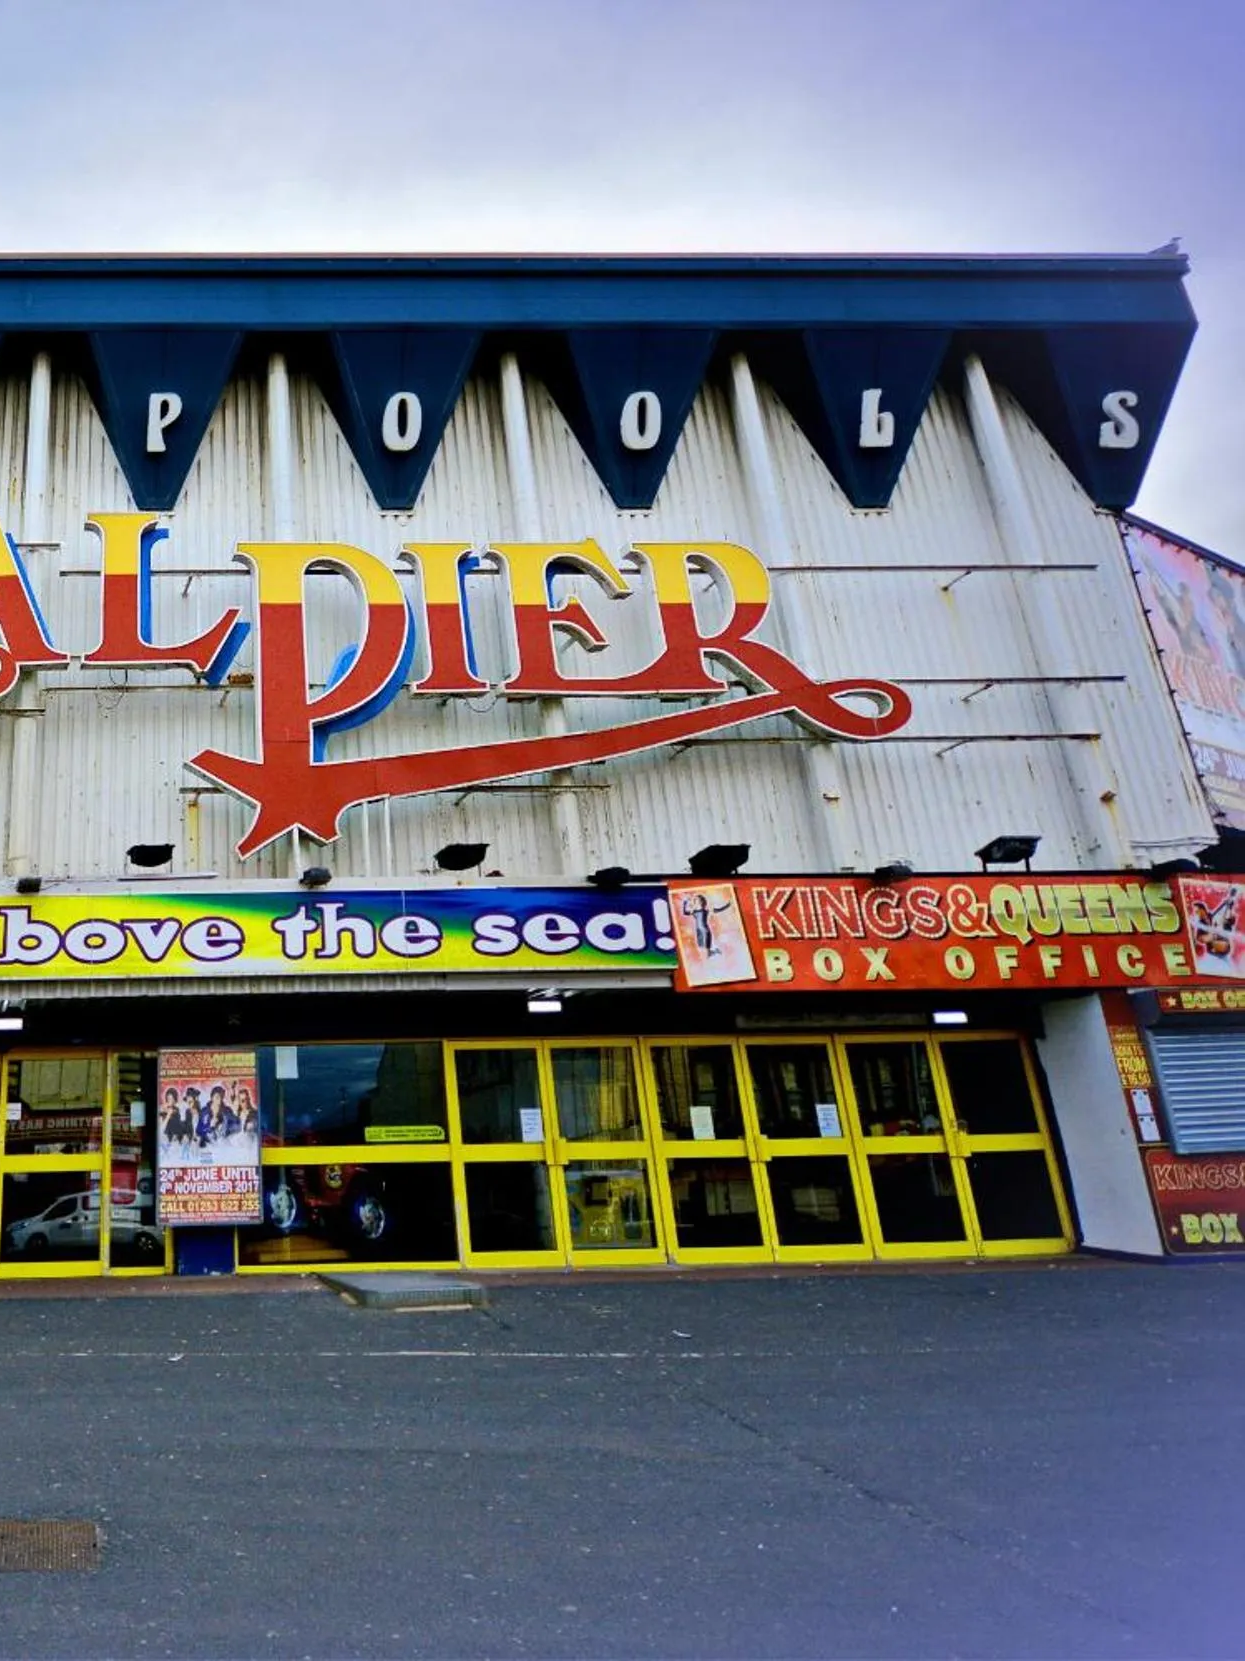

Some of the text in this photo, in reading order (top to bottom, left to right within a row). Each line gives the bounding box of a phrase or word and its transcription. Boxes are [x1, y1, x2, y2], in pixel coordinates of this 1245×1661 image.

[184, 538, 912, 859] PIER
[272, 901, 444, 960] the
[471, 897, 677, 956] sea!
[763, 944, 1192, 983] BOX OFFICE
[1180, 990, 1221, 1009] BOX
[175, 1180, 233, 1194] NOVEMBER
[235, 1179, 260, 1193] 2017
[183, 1167, 219, 1181] JUNE
[221, 1165, 260, 1180] UNTIL
[1152, 1161, 1245, 1191] KINGS
[159, 1200, 185, 1213] CALL
[1180, 1212, 1244, 1244] BOX
